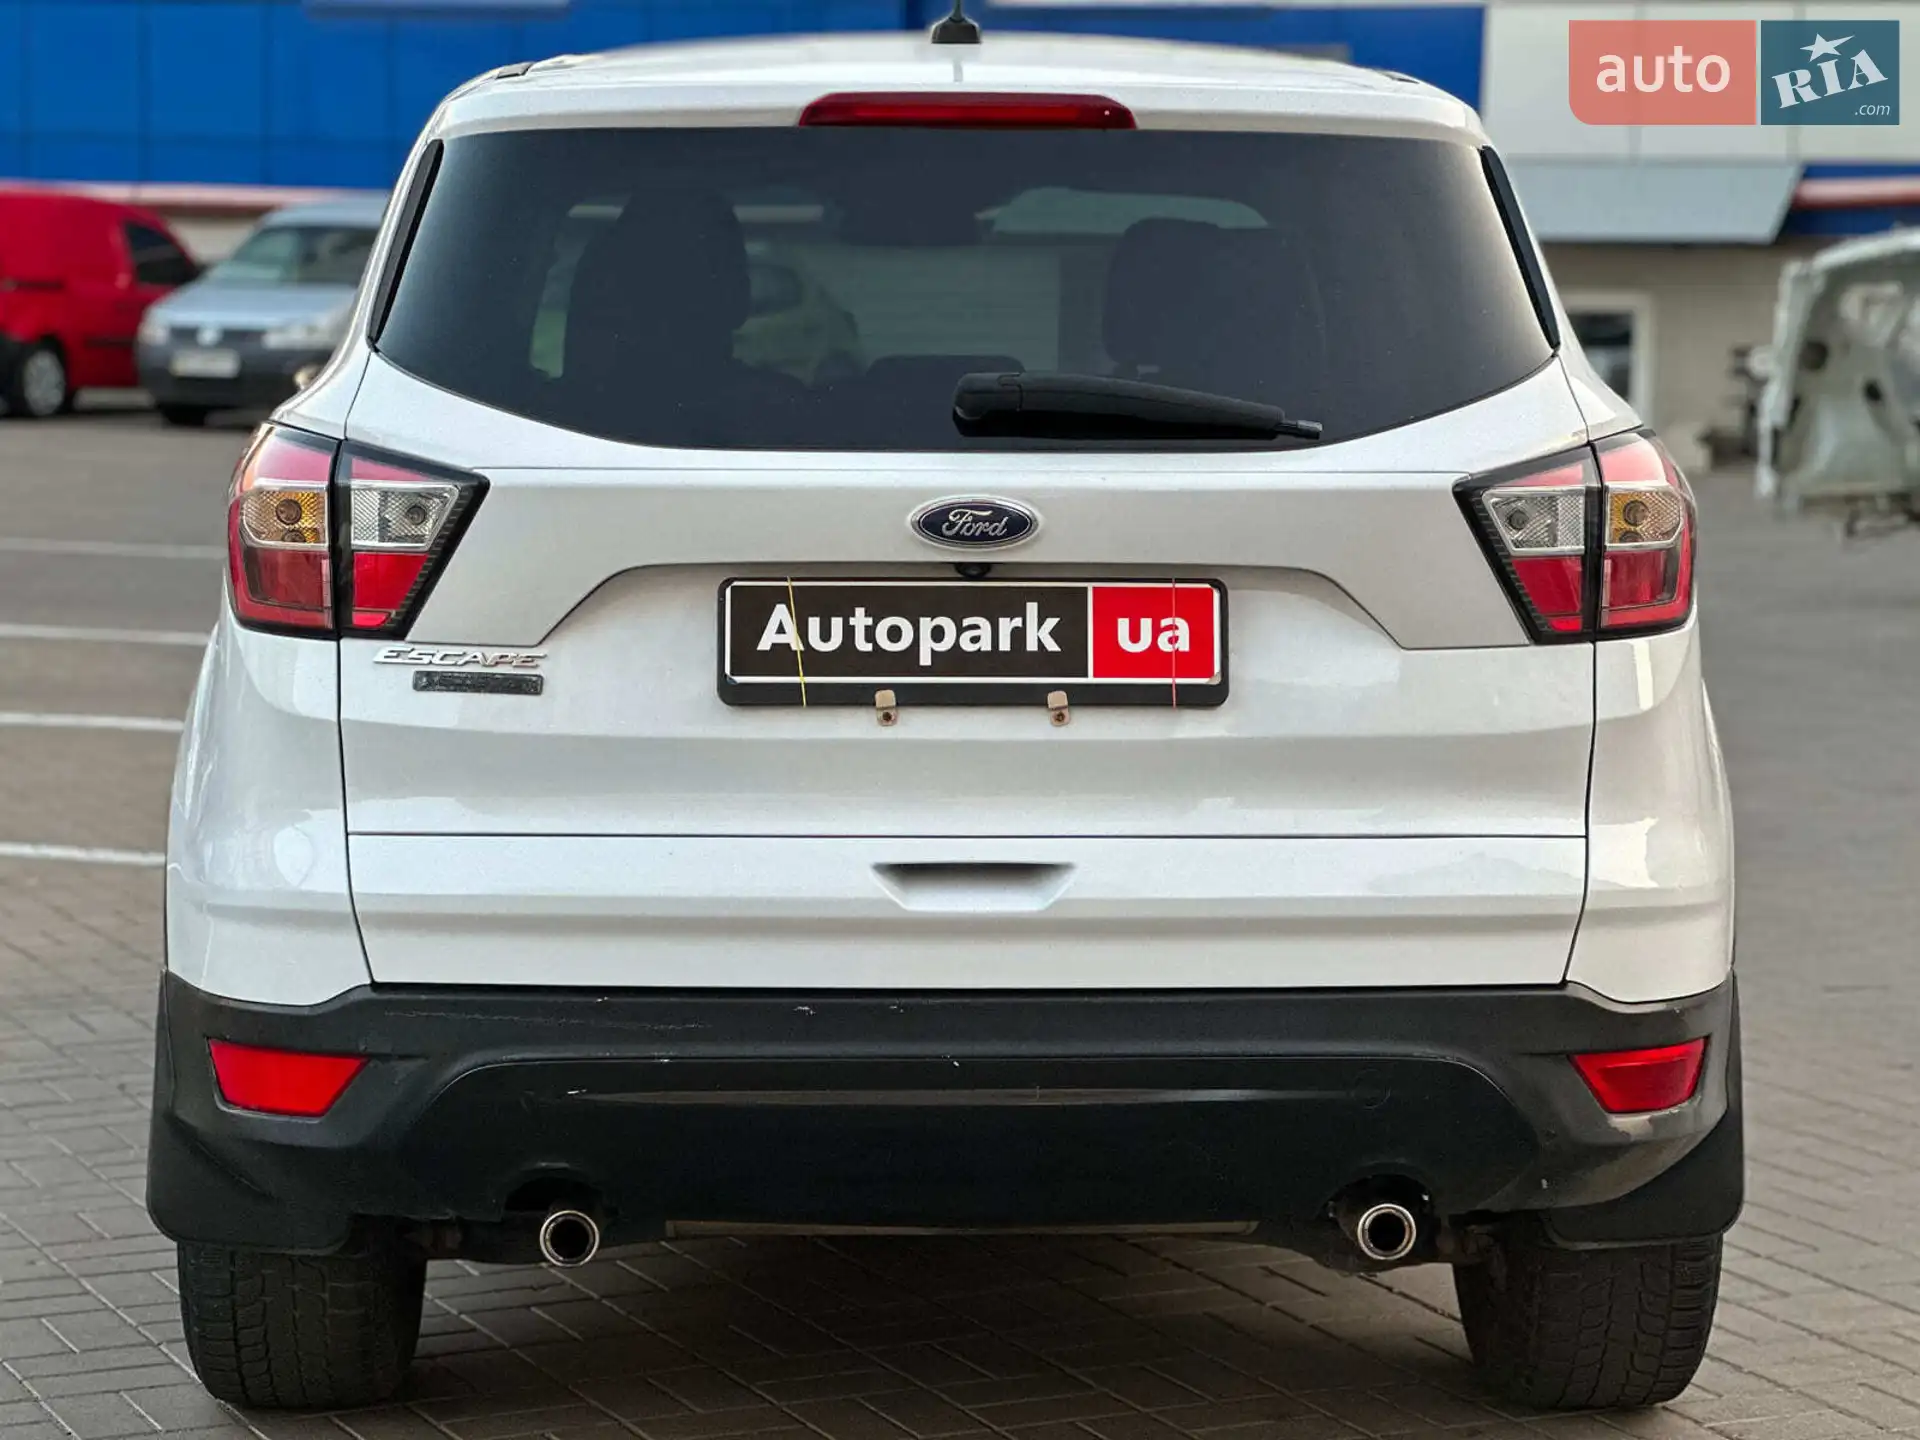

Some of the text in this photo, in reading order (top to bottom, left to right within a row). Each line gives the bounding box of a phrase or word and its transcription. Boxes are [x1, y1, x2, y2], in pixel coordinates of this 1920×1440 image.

[941, 508, 1008, 536] Ford
[757, 602, 1191, 666] Autopark ua
[373, 646, 547, 667] ESCAPE
